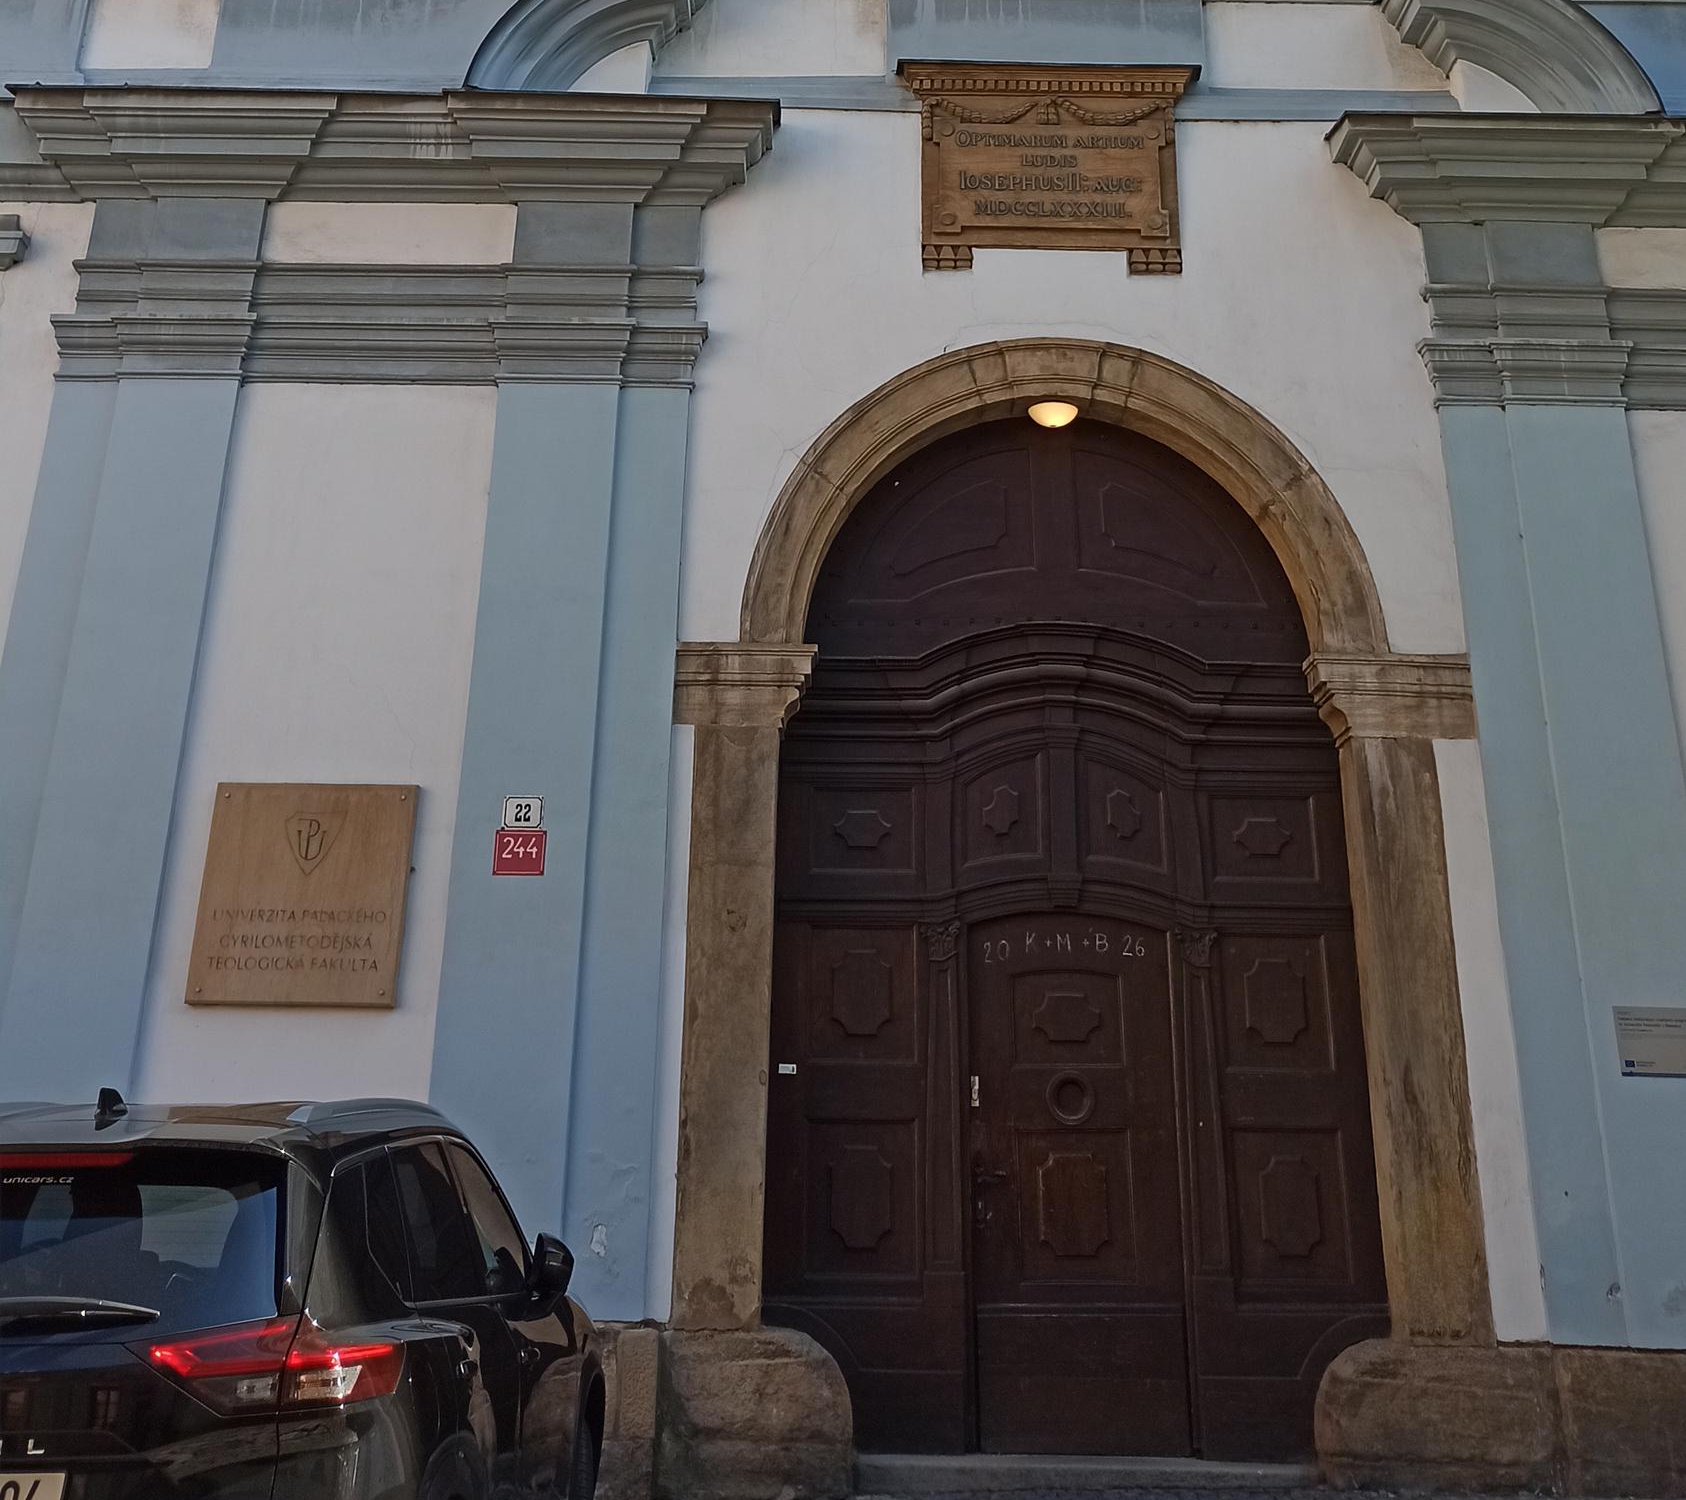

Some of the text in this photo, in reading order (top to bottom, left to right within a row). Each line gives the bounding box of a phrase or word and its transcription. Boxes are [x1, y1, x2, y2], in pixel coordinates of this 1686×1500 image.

[955, 129, 1145, 149] OPTIMARUM ARTIUM
[1021, 153, 1078, 168] LUDIS
[514, 803, 532, 822] 22
[502, 837, 538, 859] 244
[212, 908, 387, 924] UNIVERZITA PALACKÉHO
[219, 932, 373, 953] CYRILOMETODĚJSKÁ
[983, 940, 1011, 963] 20
[1122, 934, 1146, 957] 26
[208, 954, 379, 973] TEOLOGICKÁ FAKULTA
[3, 1176, 75, 1185] unicars.cz
